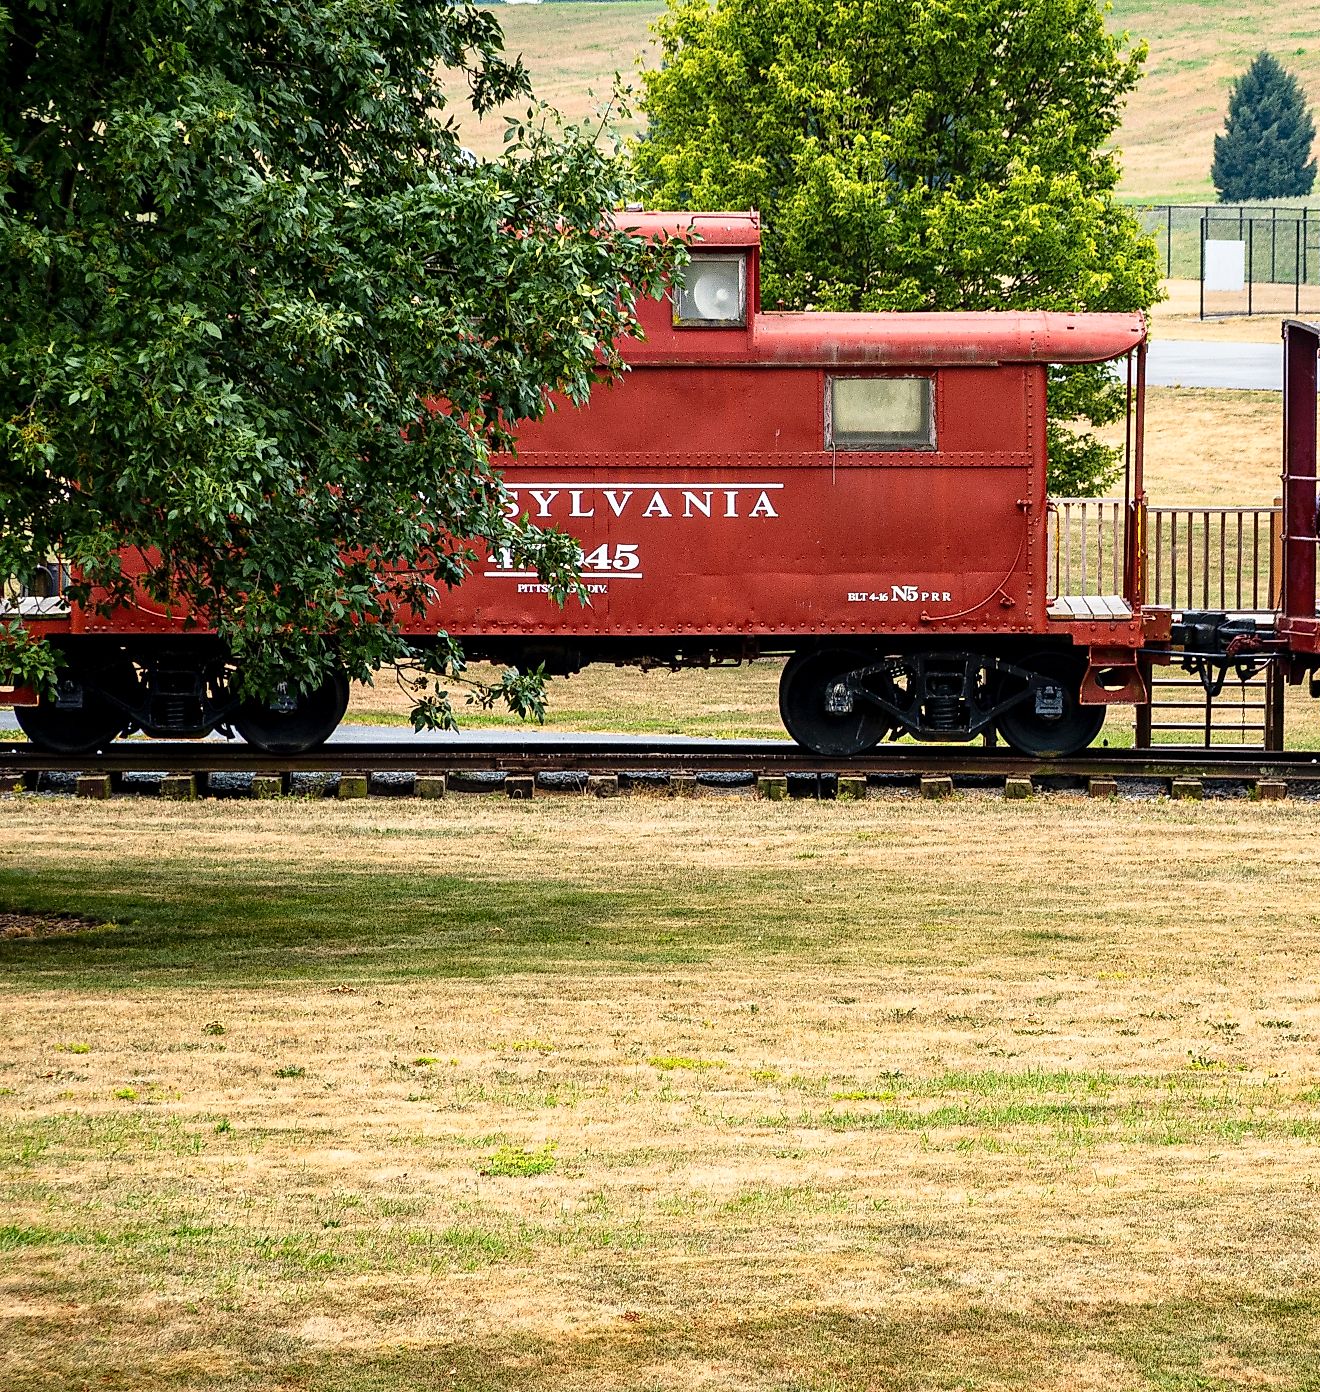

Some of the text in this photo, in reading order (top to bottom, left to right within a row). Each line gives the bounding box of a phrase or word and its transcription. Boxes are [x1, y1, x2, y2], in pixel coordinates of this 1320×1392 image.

[498, 491, 779, 518] SYLVANIA
[847, 592, 869, 602] BLT
[890, 585, 919, 602] N5
